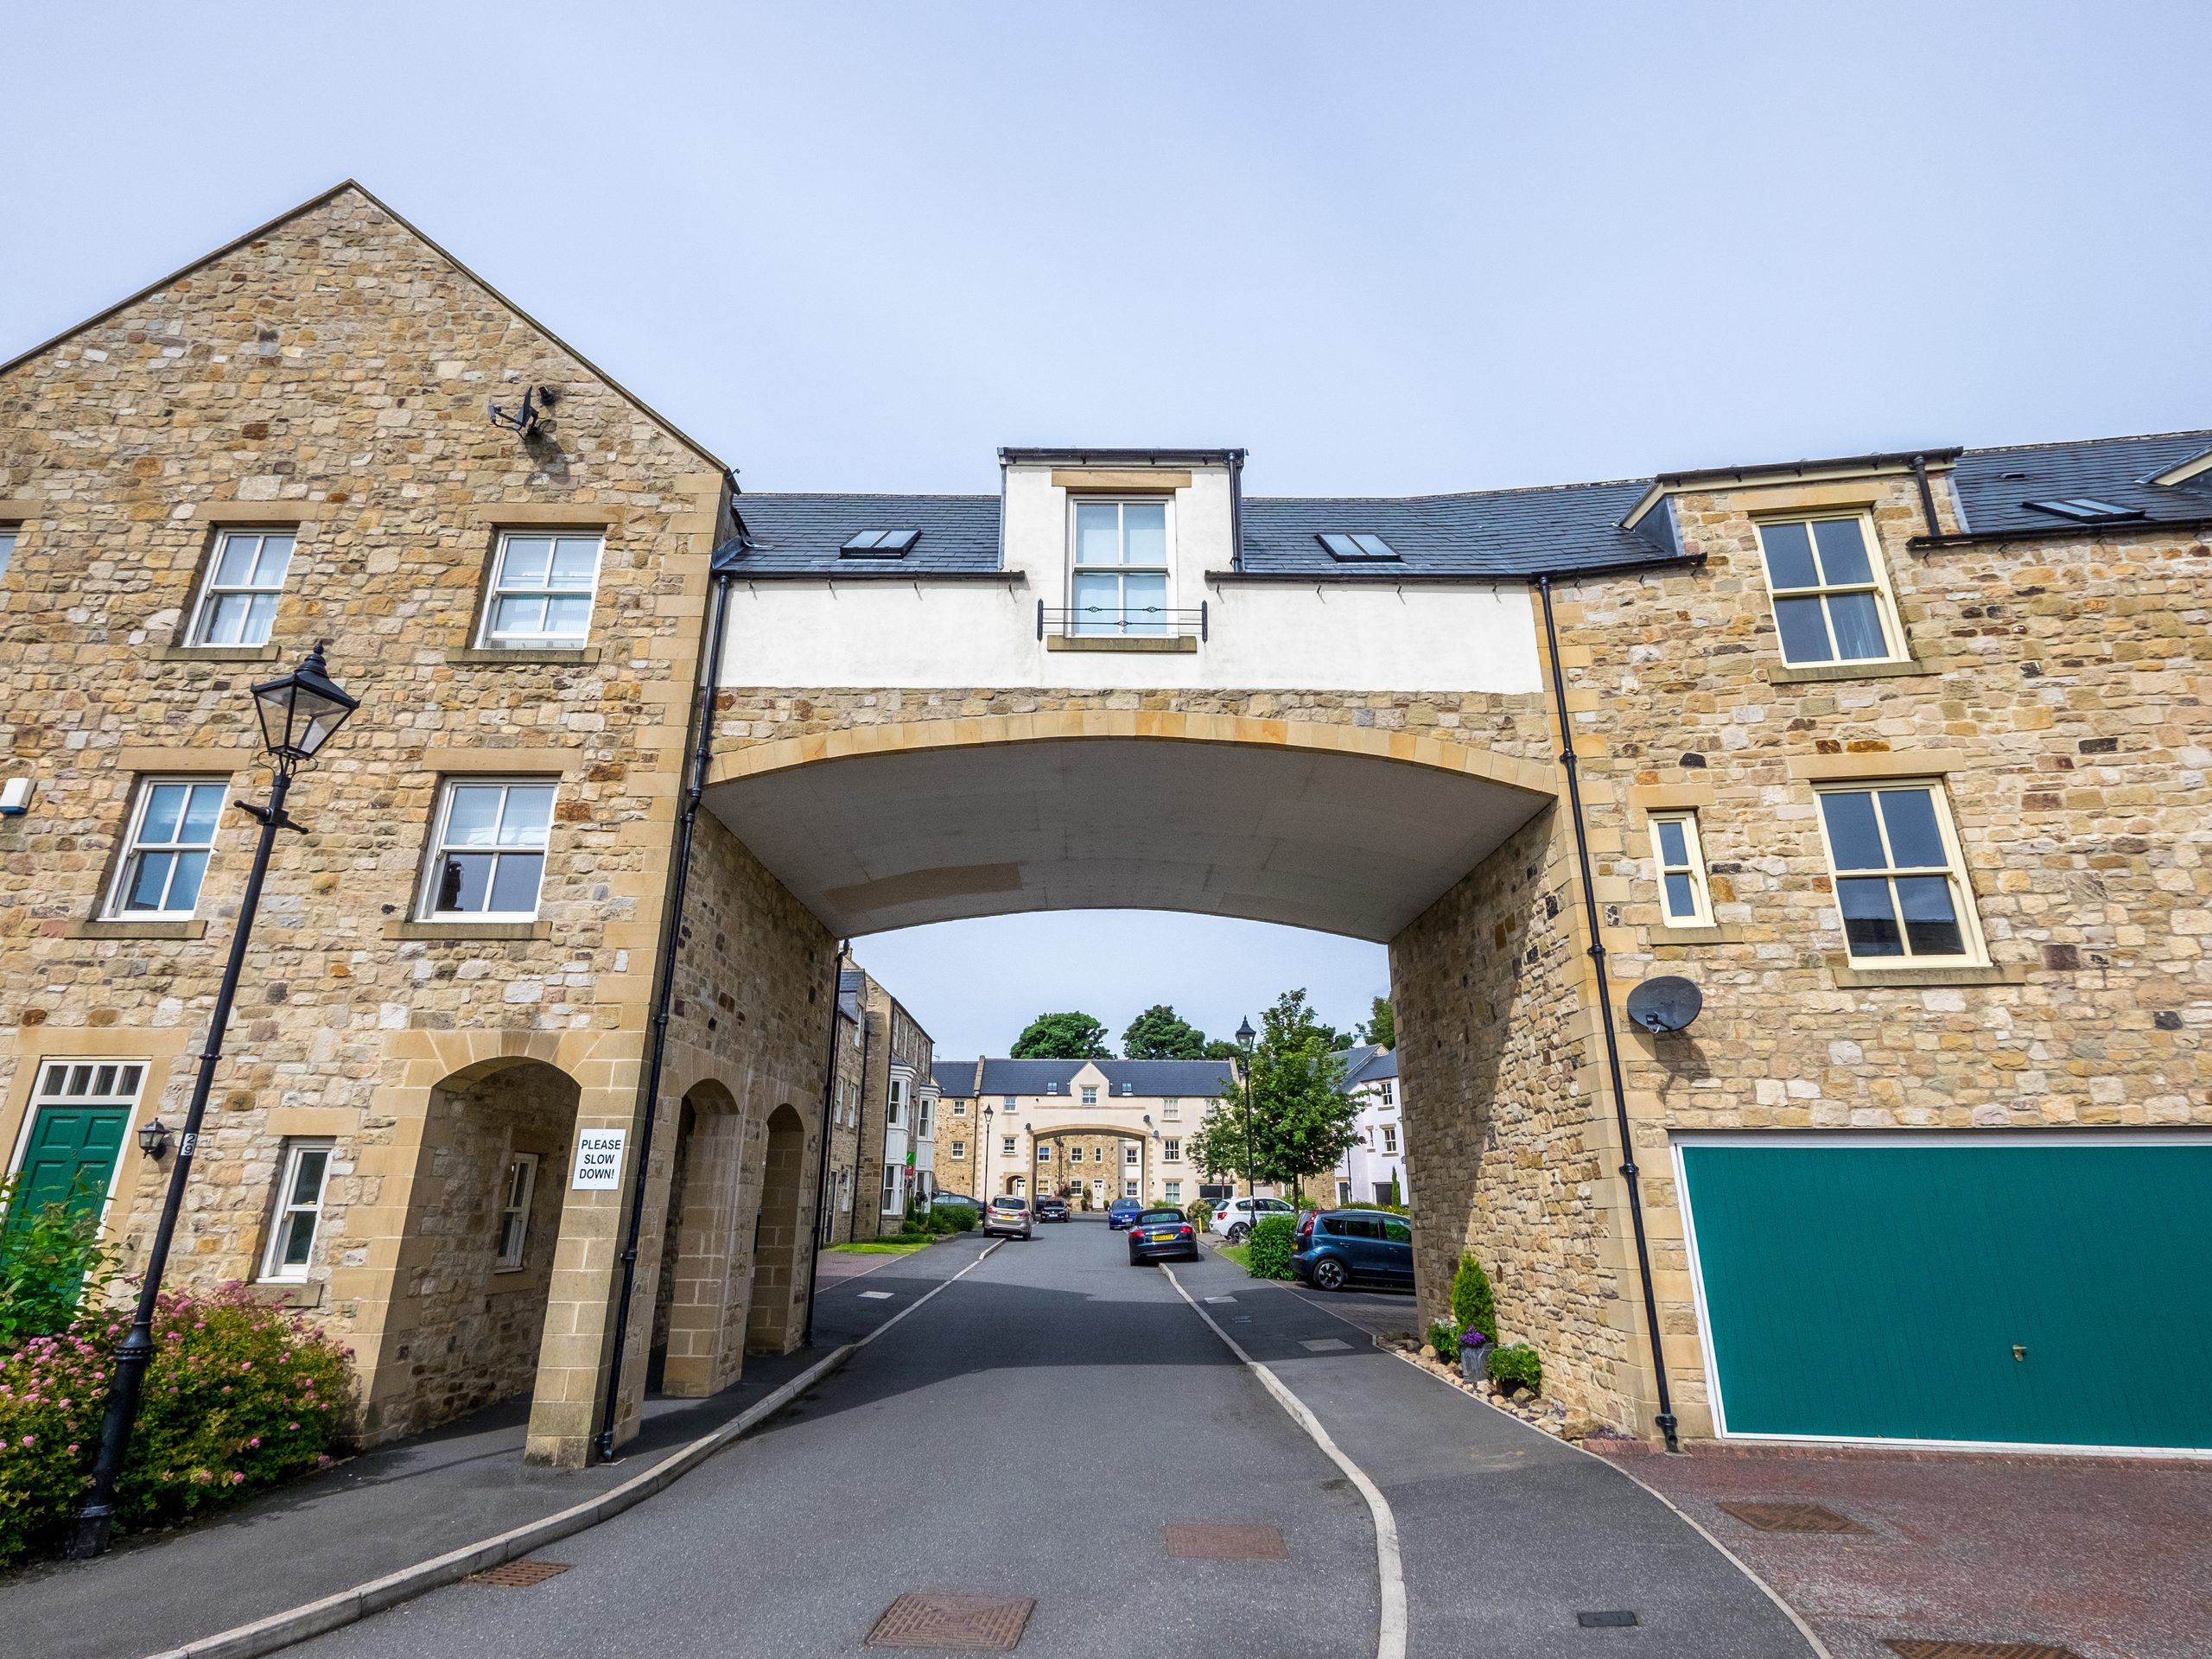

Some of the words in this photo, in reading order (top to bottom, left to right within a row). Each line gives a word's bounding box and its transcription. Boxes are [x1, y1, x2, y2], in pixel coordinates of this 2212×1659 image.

[582, 1140, 621, 1150] PLEASE
[584, 1154, 614, 1165] SLOW
[579, 1168, 614, 1179] DOWN!
